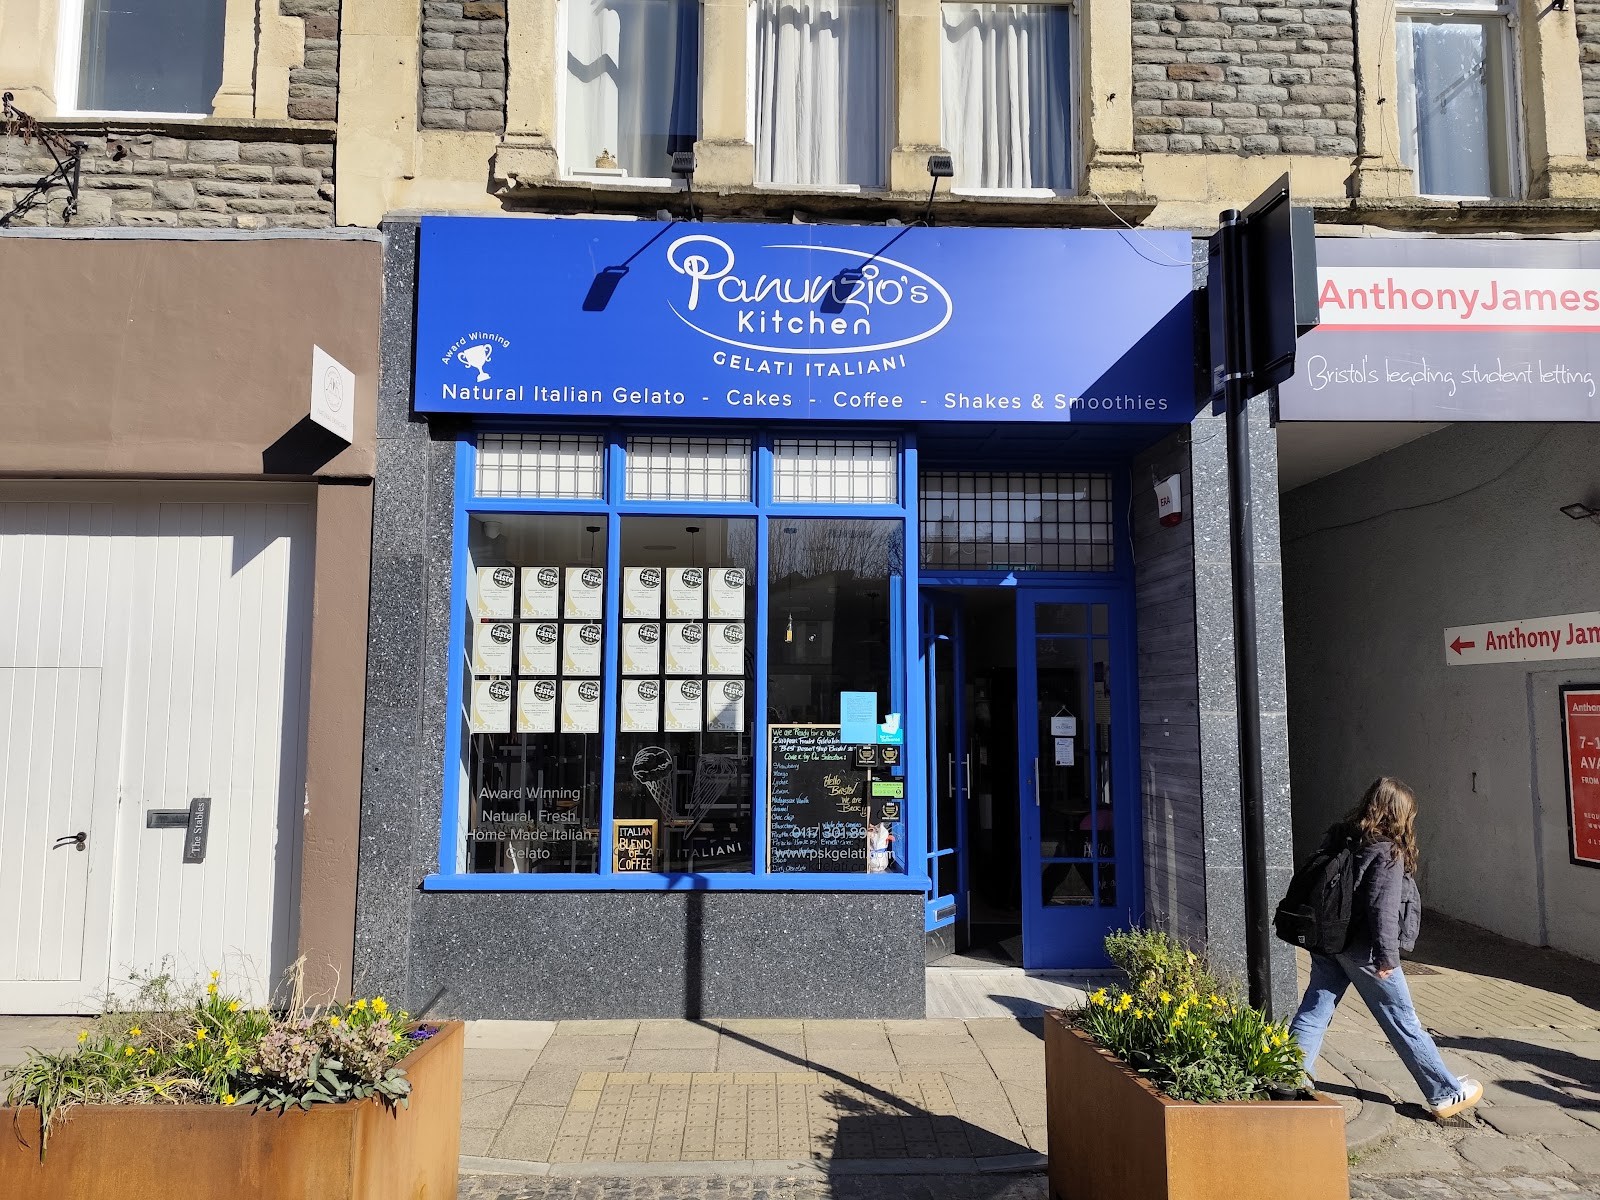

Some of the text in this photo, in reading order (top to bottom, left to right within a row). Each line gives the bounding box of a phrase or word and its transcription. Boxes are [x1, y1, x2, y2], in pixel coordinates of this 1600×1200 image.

[667, 235, 929, 315] Panunzio's
[1319, 278, 1600, 319] AnthonyJames
[738, 309, 871, 335] Kitchen
[441, 332, 511, 365] Award Winning
[712, 351, 906, 377] GELATI ITALIANI
[1307, 355, 1595, 397] Bristol's leading student letting
[442, 383, 524, 402] Natural
[534, 385, 603, 403] Italian
[613, 387, 686, 405] Gelato
[726, 389, 793, 407] Cakes
[833, 391, 903, 409] Coffee
[944, 392, 1022, 410] Shakes
[1031, 393, 1045, 409] &
[1054, 393, 1169, 411] Smoothies
[494, 573, 513, 583] taste
[538, 573, 558, 583] taste
[582, 573, 602, 583] taste
[641, 573, 660, 584] taste
[683, 573, 702, 584] taste
[725, 573, 744, 584] taste
[492, 629, 511, 640] taste
[537, 629, 556, 640] taste
[581, 630, 600, 640] taste
[639, 628, 658, 640] taste
[683, 628, 702, 640] taste
[724, 628, 743, 640] taste
[1486, 623, 1600, 652] Anthony Jam
[490, 685, 510, 696] taste
[535, 685, 554, 696] taste
[579, 686, 598, 697] taste
[639, 685, 658, 697] taste
[682, 685, 701, 696] taste
[724, 685, 743, 696] taste
[1581, 777, 1599, 785] FROM
[479, 787, 580, 801] Award Winning
[482, 810, 576, 824] Natural, Fresh
[191, 802, 205, 854] The Stables
[619, 827, 652, 837] ITALIAN
[792, 827, 819, 839] 0117
[466, 828, 592, 841] Home Made Italian
[619, 837, 652, 850] BLEND
[506, 847, 550, 859] Gelato
[776, 847, 896, 861] www.pskgelati.m
[618, 858, 652, 871] COFFEE
